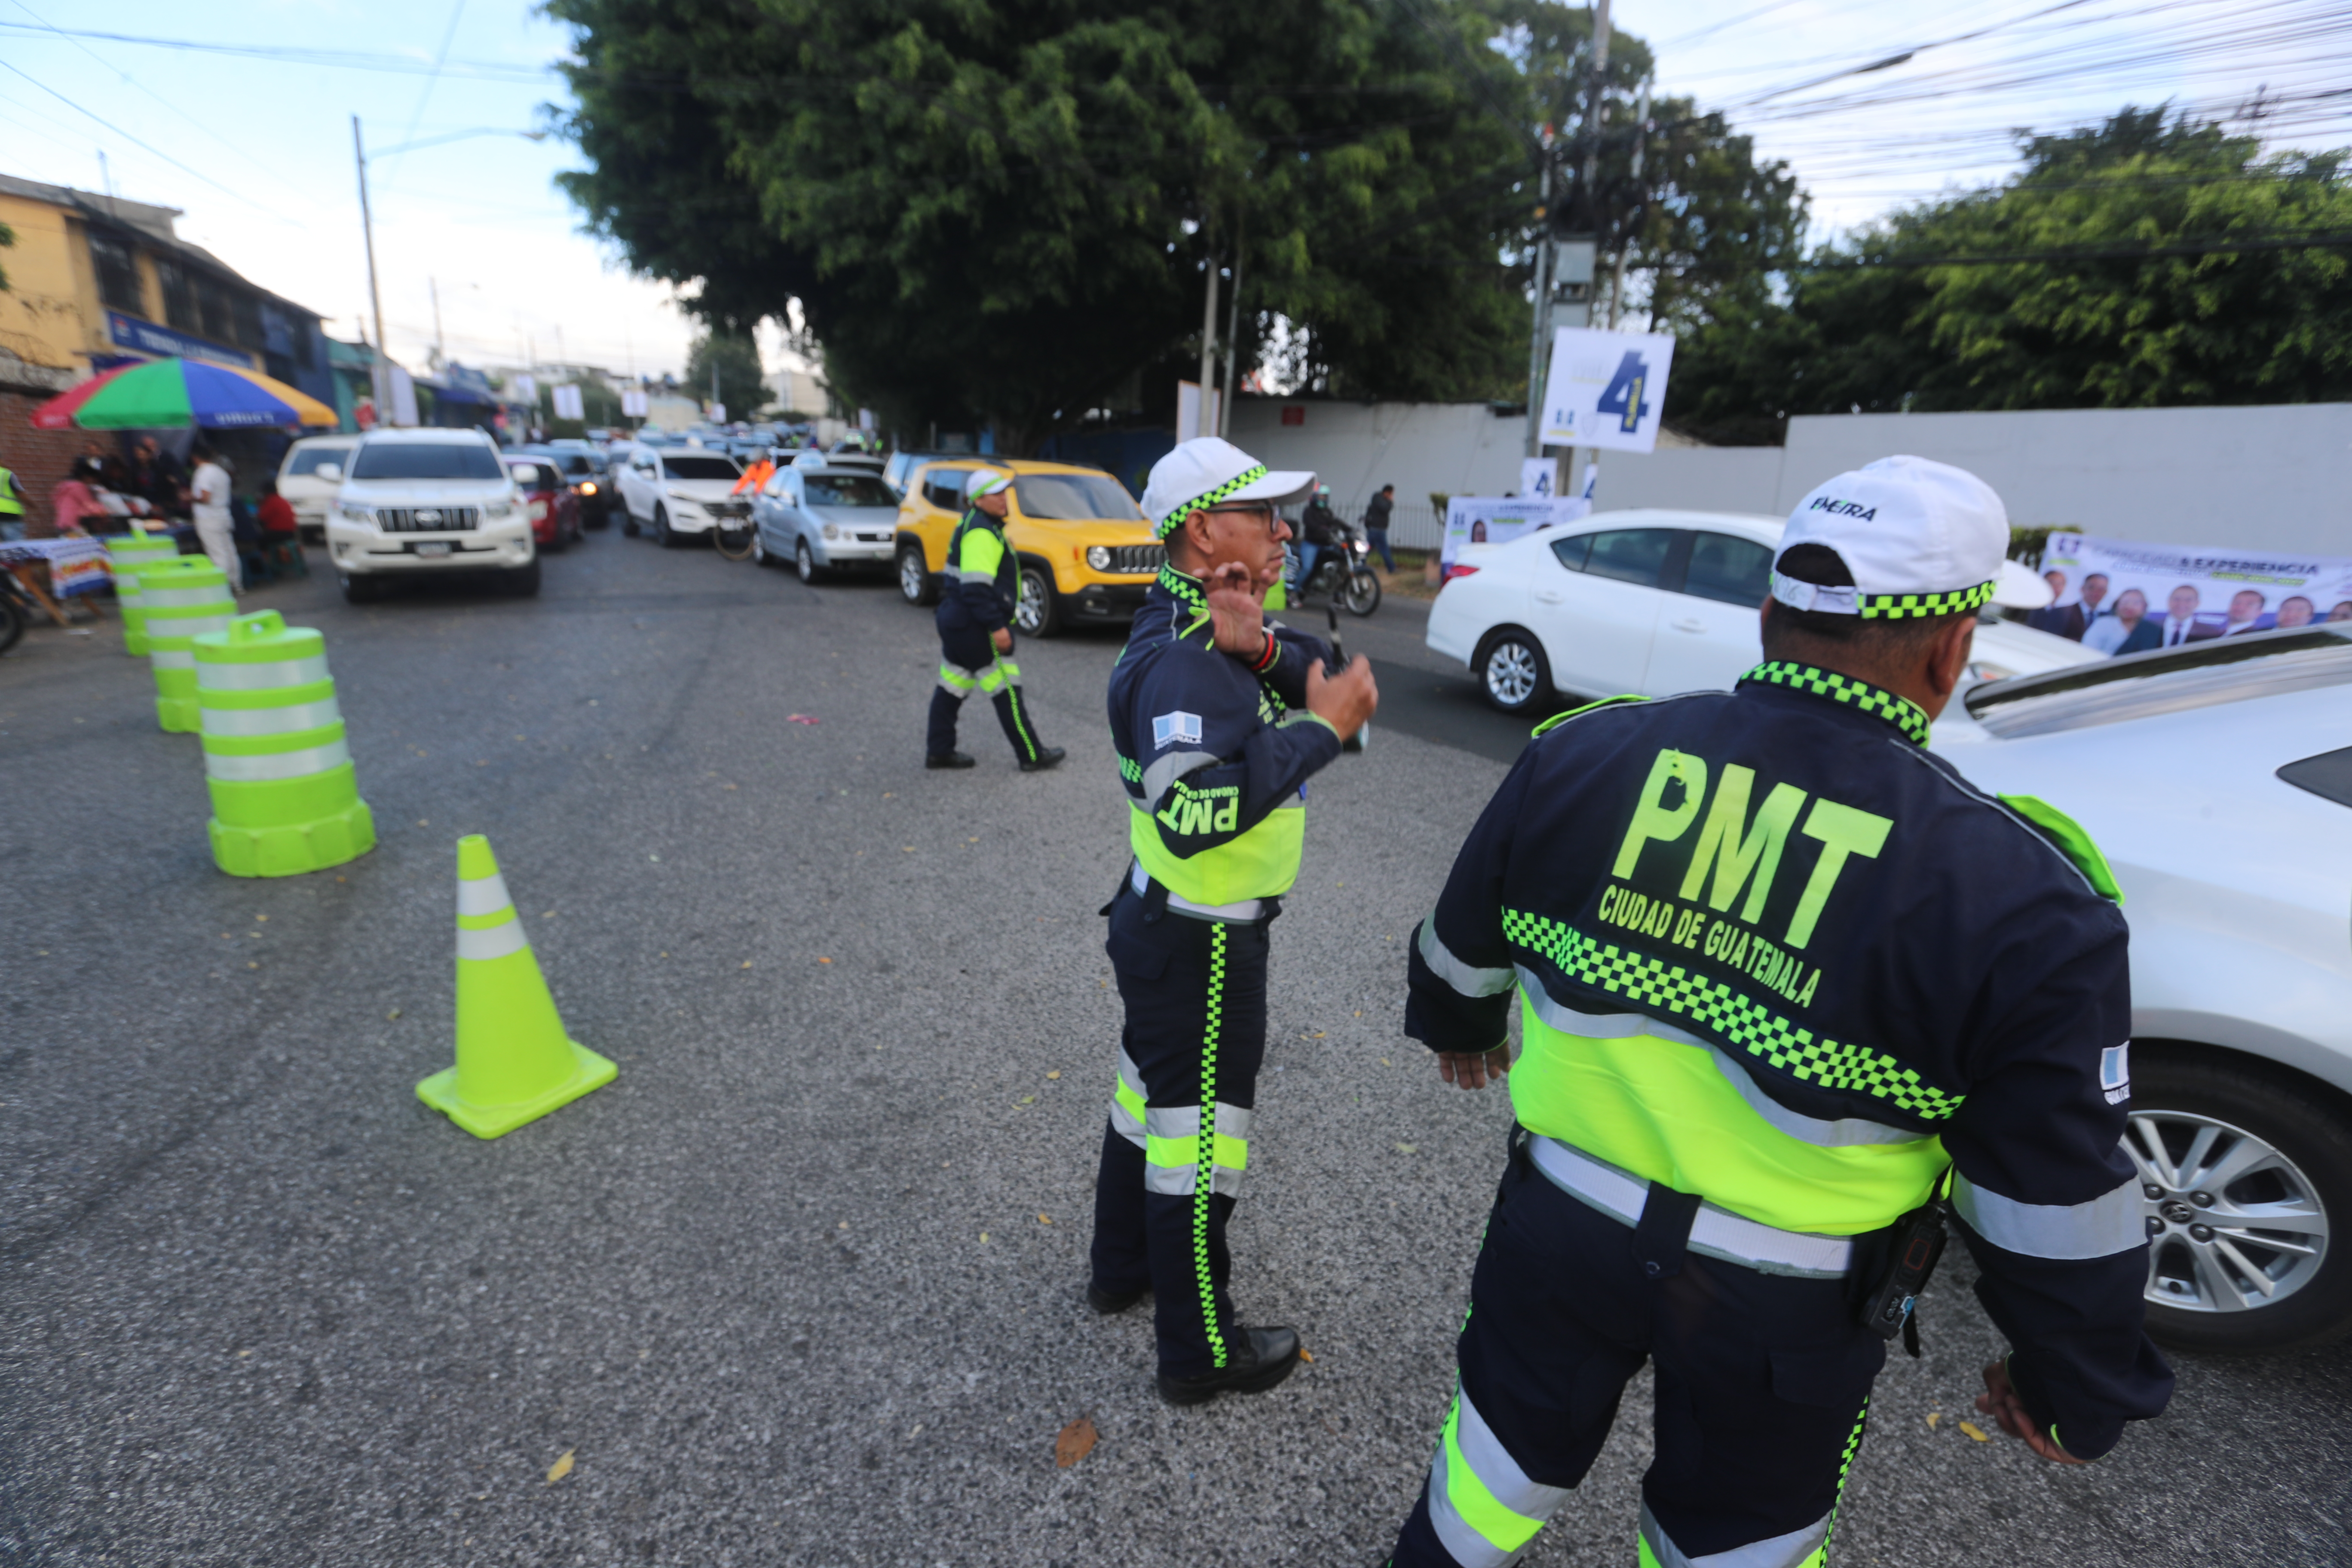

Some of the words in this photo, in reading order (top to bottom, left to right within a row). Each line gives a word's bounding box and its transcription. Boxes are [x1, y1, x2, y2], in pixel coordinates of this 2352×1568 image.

[1597, 352, 1648, 433] 4
[1535, 472, 1550, 497] 4
[2195, 558, 2319, 576] EXPERIENCIA
[1156, 793, 1239, 836] PMT
[1611, 748, 1894, 949] PMT
[1598, 884, 1674, 939] CIUDAD
[1672, 908, 1706, 949] DE
[1704, 920, 1822, 1008] GUATEMALA
